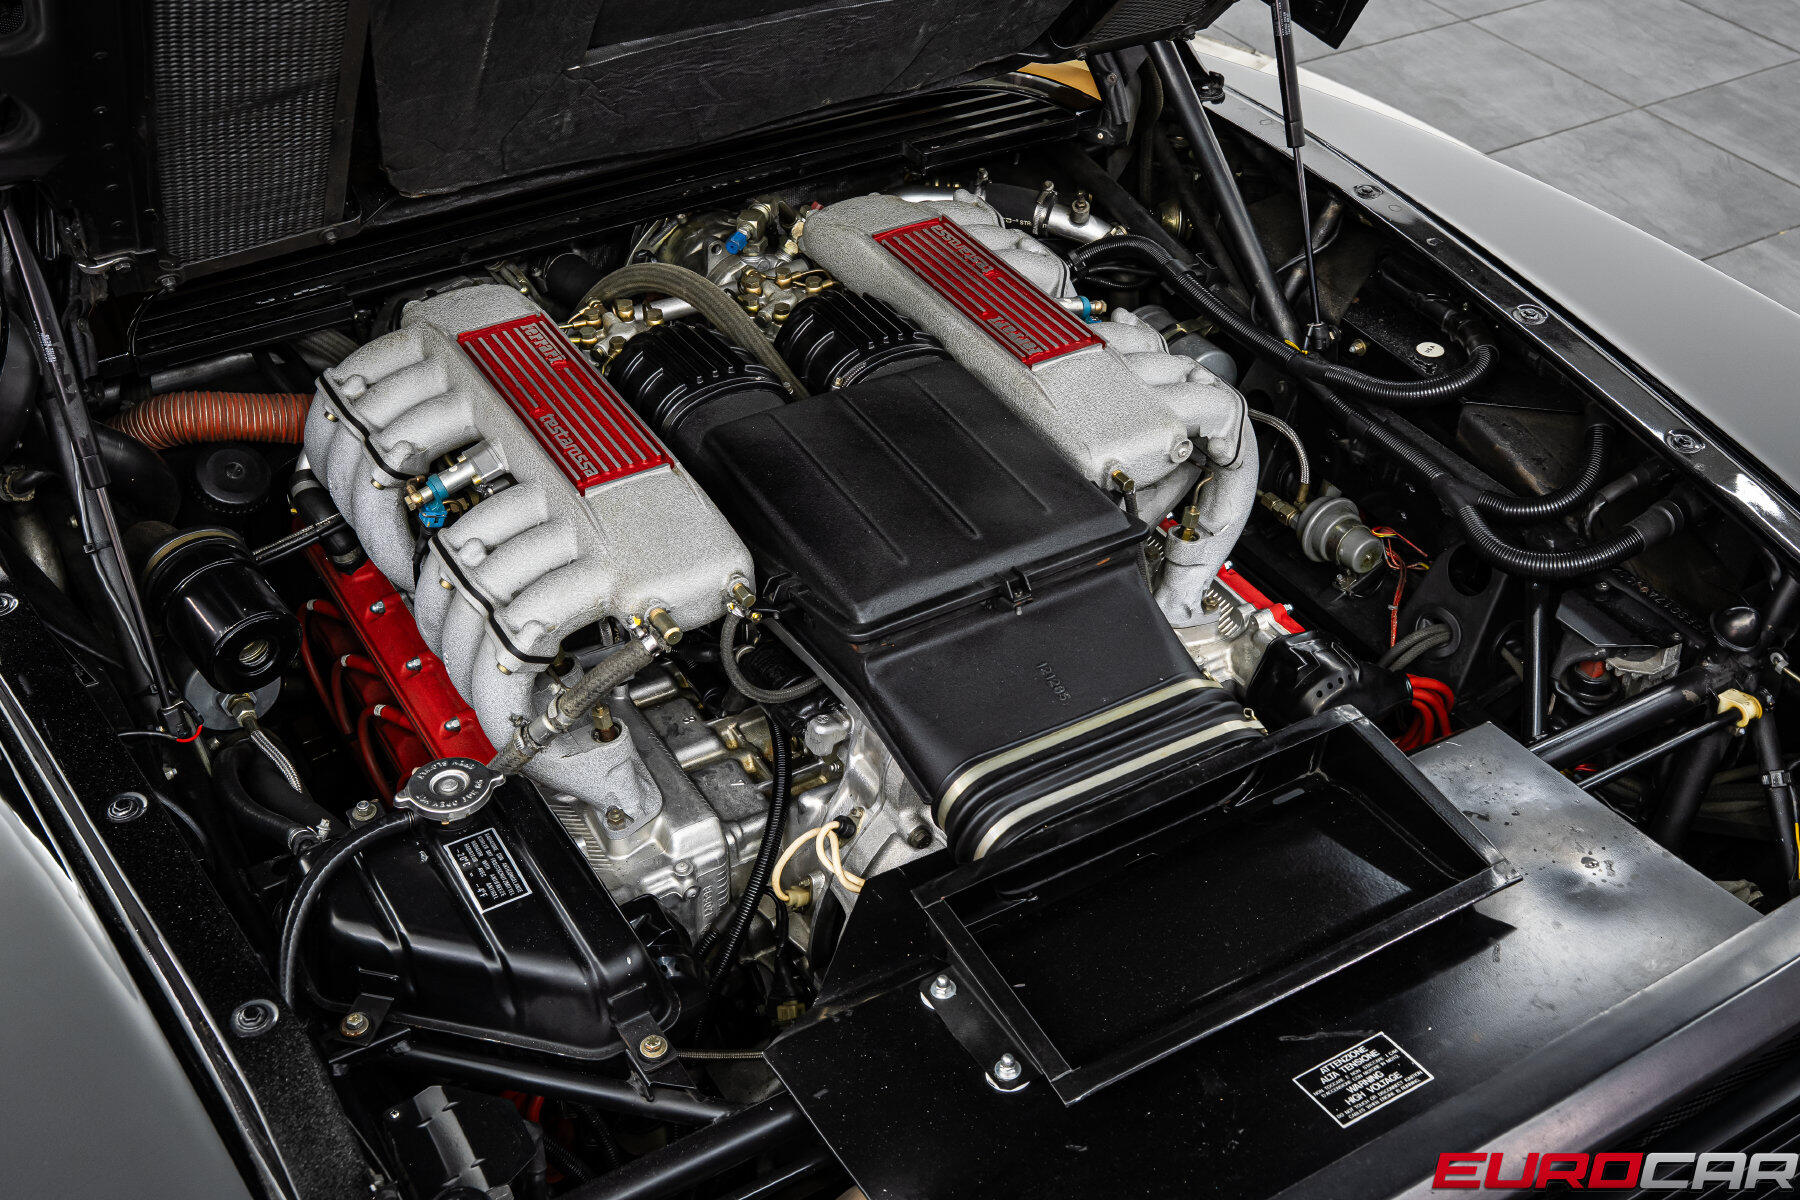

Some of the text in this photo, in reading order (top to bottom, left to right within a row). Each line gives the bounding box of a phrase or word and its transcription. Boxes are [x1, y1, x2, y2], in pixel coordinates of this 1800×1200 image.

[1320, 1046, 1368, 1074] ATTENZIONE
[1320, 1049, 1380, 1084] ALTA TENSIONE
[1345, 1071, 1403, 1105] HIGH VOLTAGE
[1346, 1071, 1384, 1093] WARNING
